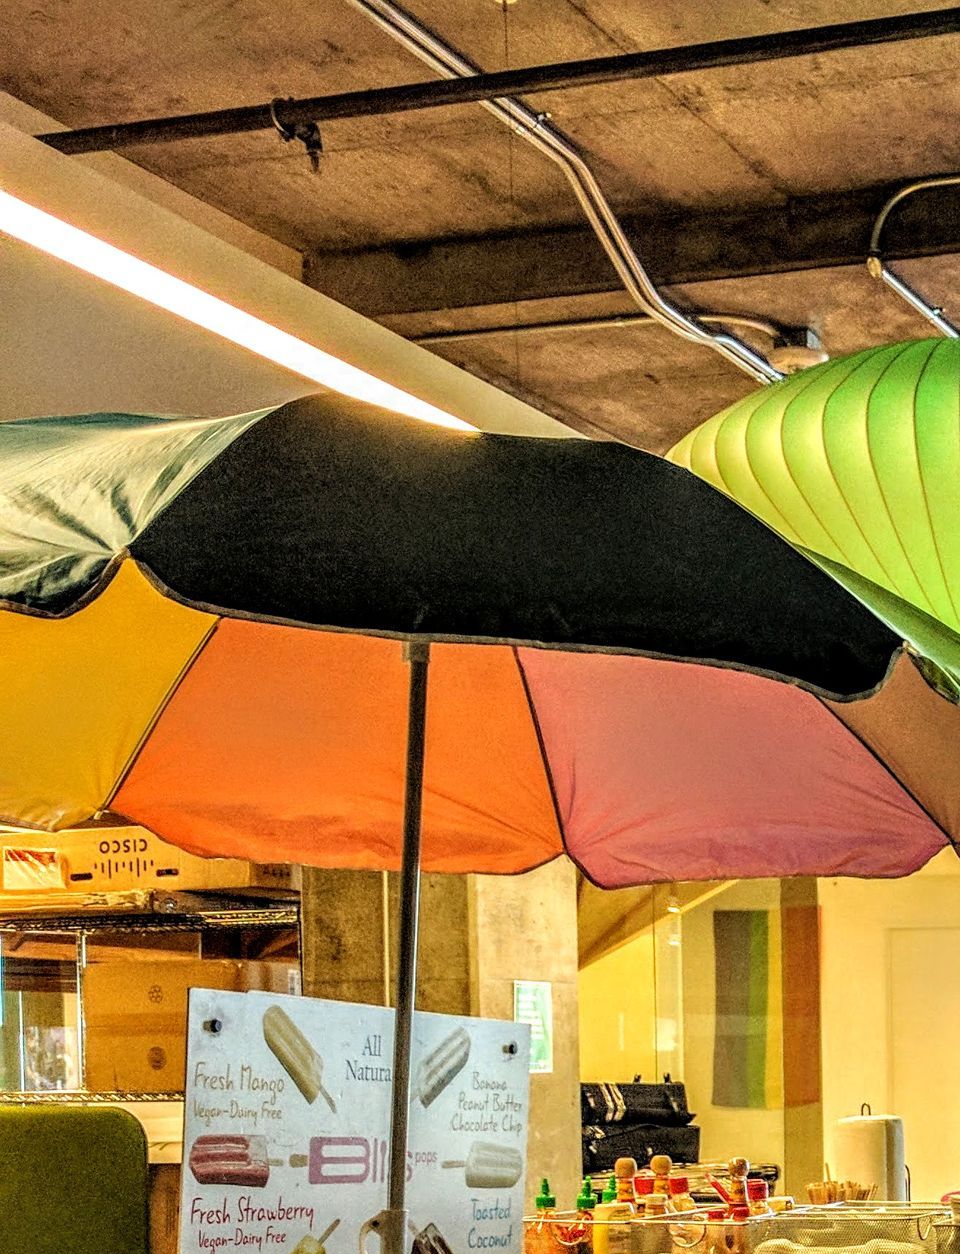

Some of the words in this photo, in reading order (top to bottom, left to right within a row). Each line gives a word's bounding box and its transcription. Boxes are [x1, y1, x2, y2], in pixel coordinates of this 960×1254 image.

[99, 838, 148, 854] CISCO
[361, 1034, 382, 1056] All
[345, 1059, 392, 1082] Natura
[472, 1071, 508, 1090] Banana
[194, 1061, 235, 1090] Fresh
[240, 1064, 285, 1105] Mango
[261, 1101, 283, 1119] Free
[458, 1091, 489, 1111] Peanut
[492, 1093, 523, 1112] Butter
[450, 1112, 498, 1133] Chocolate
[502, 1114, 523, 1137] Chip
[415, 1151, 438, 1166] pops
[190, 1197, 231, 1224] Fresh
[237, 1196, 314, 1231] Strawberry
[471, 1197, 512, 1221] Toasted
[265, 1225, 287, 1244] Free
[467, 1225, 513, 1249] Coconut
